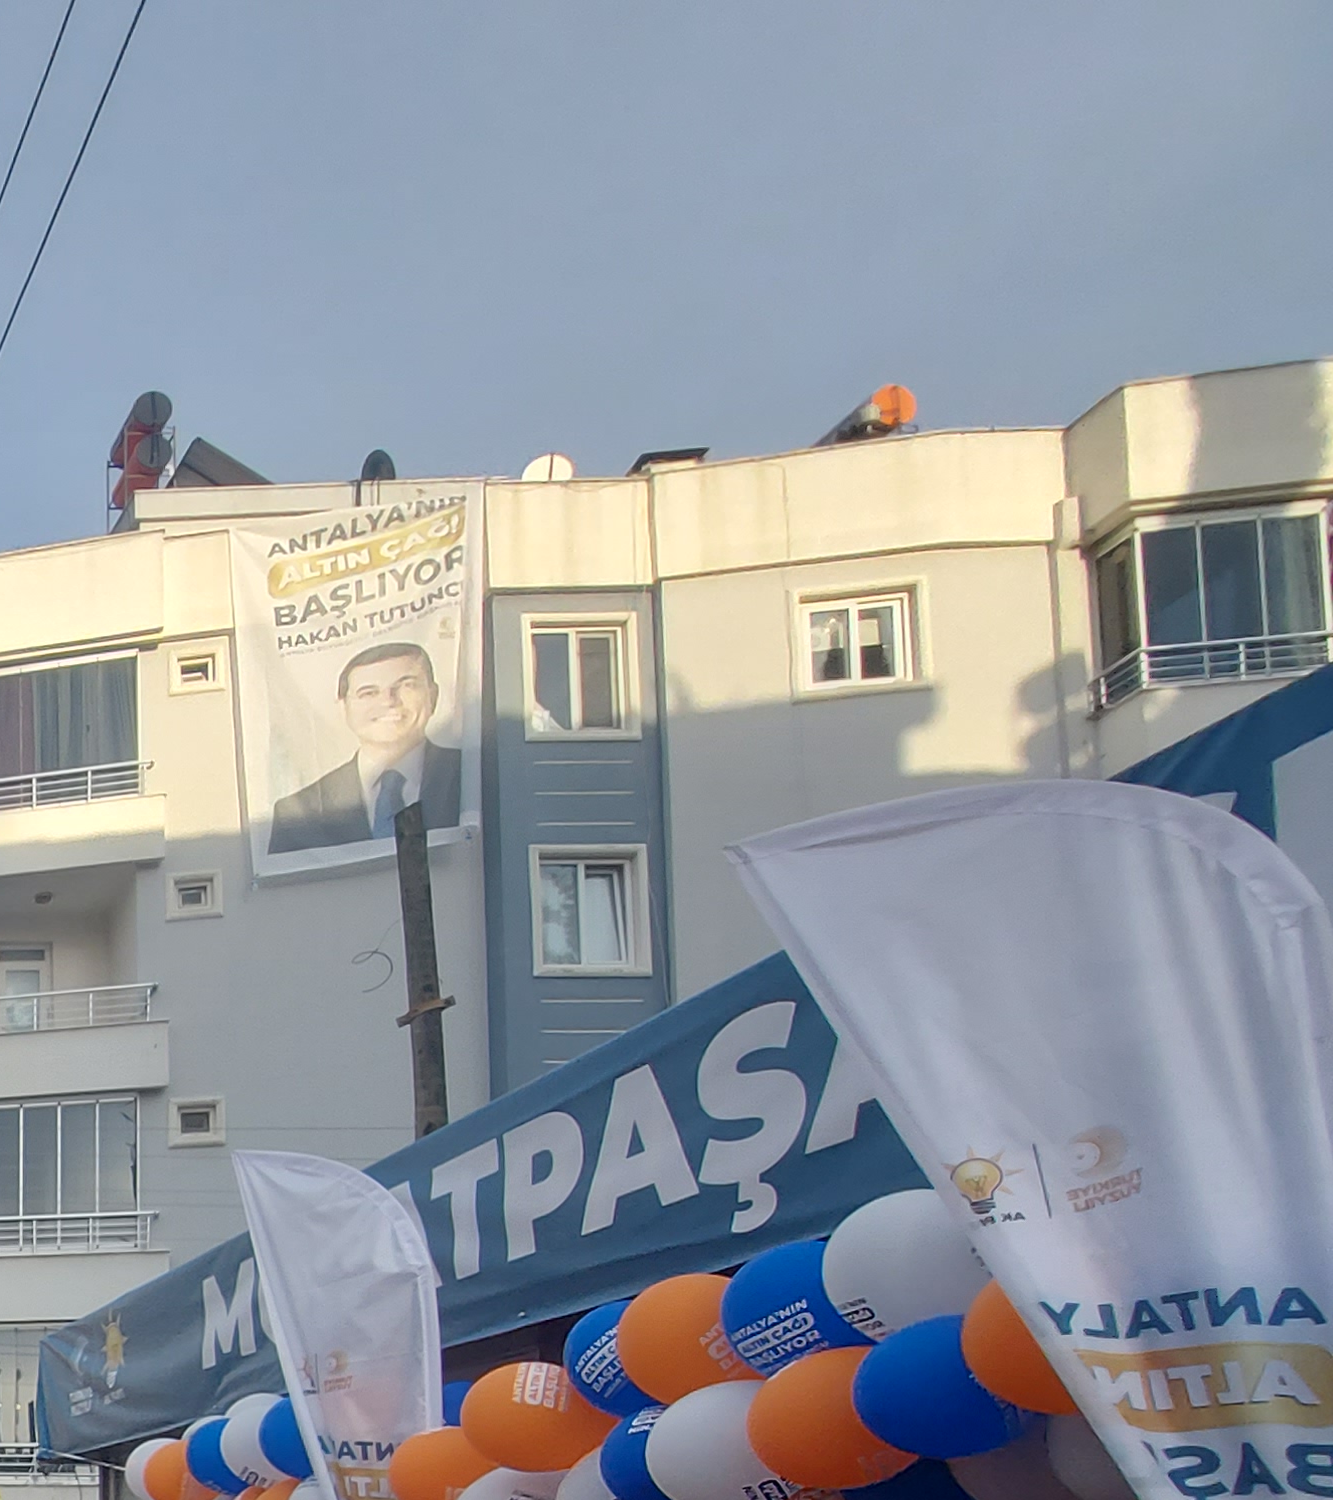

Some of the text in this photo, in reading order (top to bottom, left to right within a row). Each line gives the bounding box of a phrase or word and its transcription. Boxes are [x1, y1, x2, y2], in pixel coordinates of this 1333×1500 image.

[273, 545, 464, 627] BAŞLIYOR
[278, 547, 371, 591] ALTIN
[277, 617, 358, 651] HAKAN
[364, 581, 463, 629] TUTUNC
